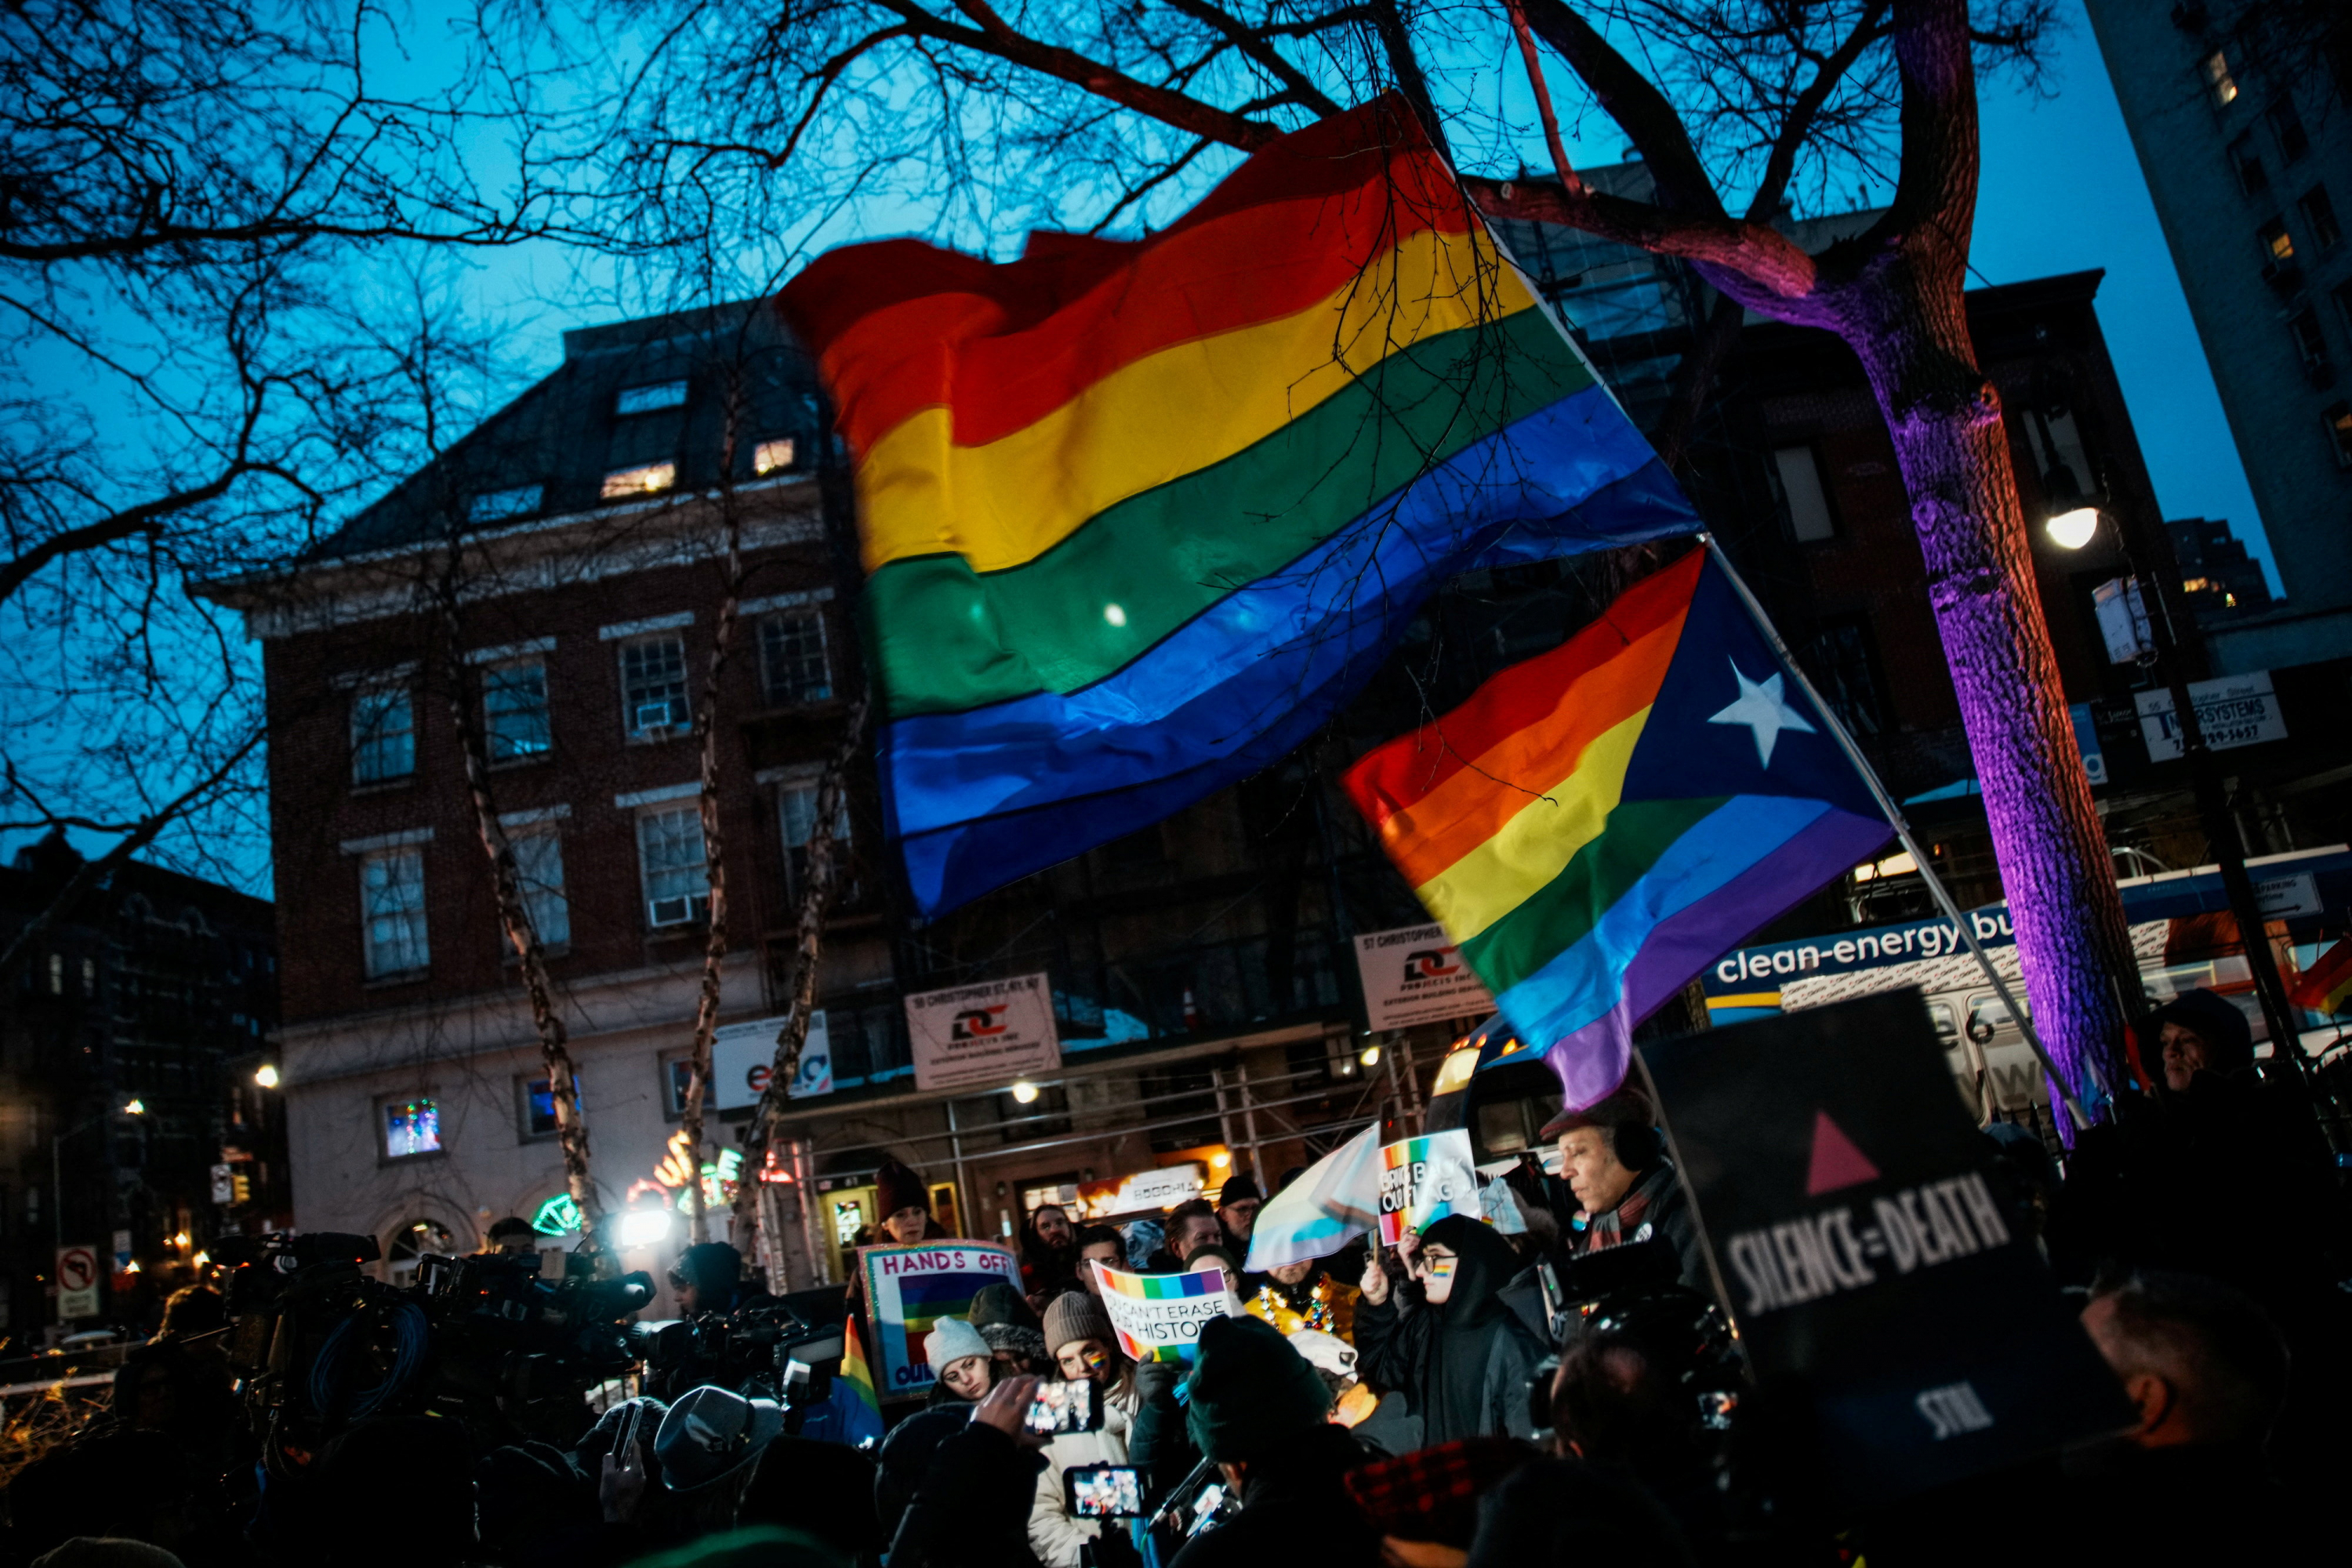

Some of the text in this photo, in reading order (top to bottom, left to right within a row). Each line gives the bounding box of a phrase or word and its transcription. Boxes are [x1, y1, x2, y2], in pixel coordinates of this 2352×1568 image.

[1715, 923, 1960, 983] clean-energy
[1970, 912, 2015, 941] bu
[882, 1251, 966, 1276] HANDS
[1123, 1301, 1164, 1319] CAN'T
[1167, 1300, 1225, 1319] ERASE
